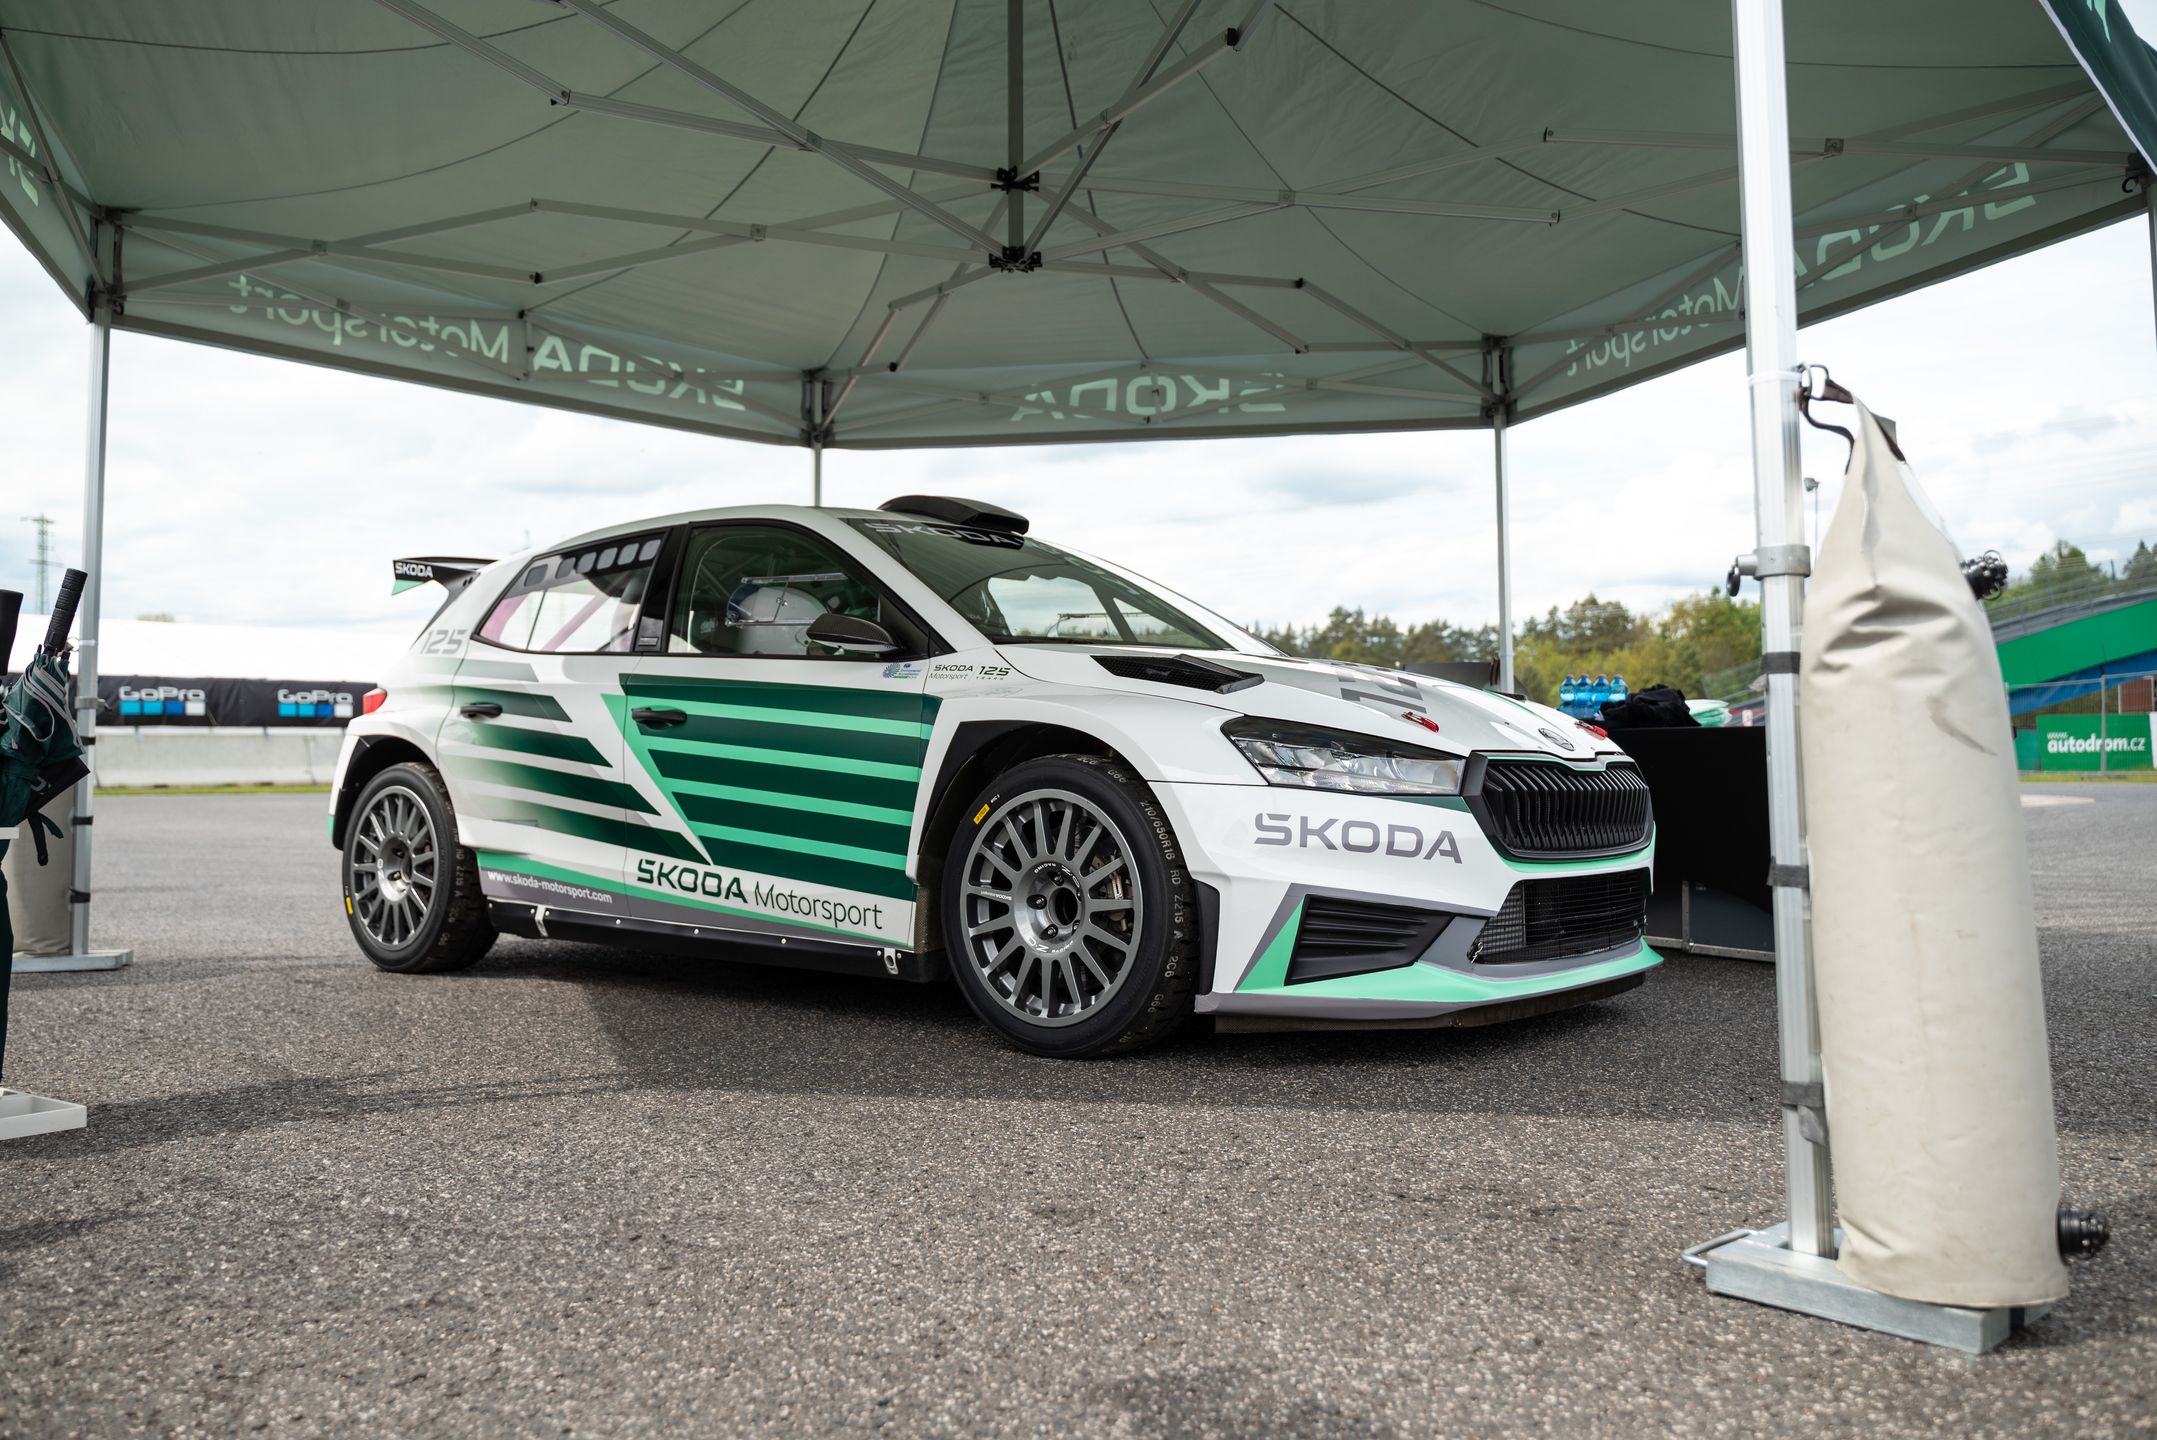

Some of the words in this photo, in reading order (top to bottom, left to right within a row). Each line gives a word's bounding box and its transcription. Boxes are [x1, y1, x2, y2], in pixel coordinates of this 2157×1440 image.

[420, 629, 467, 654] 125
[978, 666, 1011, 676] 125
[118, 686, 205, 700] GoPro
[277, 689, 352, 703] GoPro
[2047, 733, 2146, 753] autodrom.cz
[487, 871, 613, 904] www.skoda-motorsport.com
[754, 881, 883, 930] Motorsport
